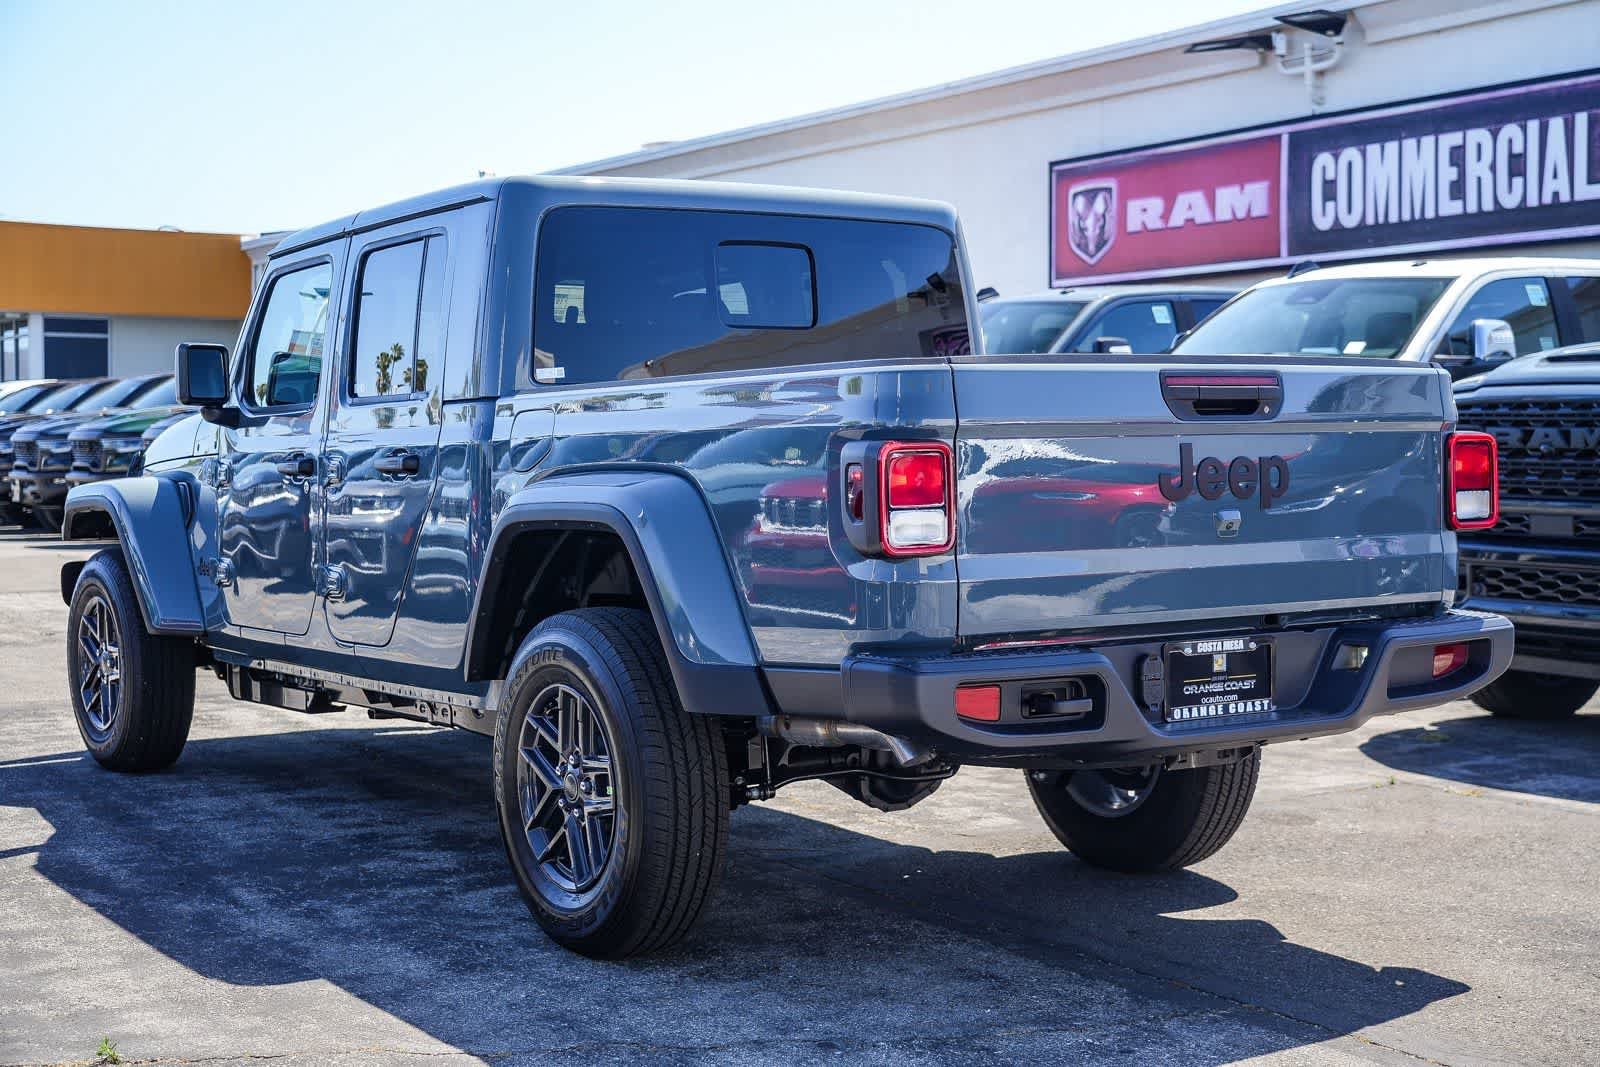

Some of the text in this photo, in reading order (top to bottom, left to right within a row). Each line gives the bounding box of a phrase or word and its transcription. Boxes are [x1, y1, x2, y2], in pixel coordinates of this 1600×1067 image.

[1126, 111, 1600, 233] RAM COMMERCIAL
[1158, 442, 1290, 512] Jeep
[1197, 639, 1244, 653] COSTA MESA
[1183, 679, 1256, 695] ORANGE COAST
[1201, 694, 1238, 704] ocauto.com
[1173, 700, 1270, 720] ORANGE COAST
